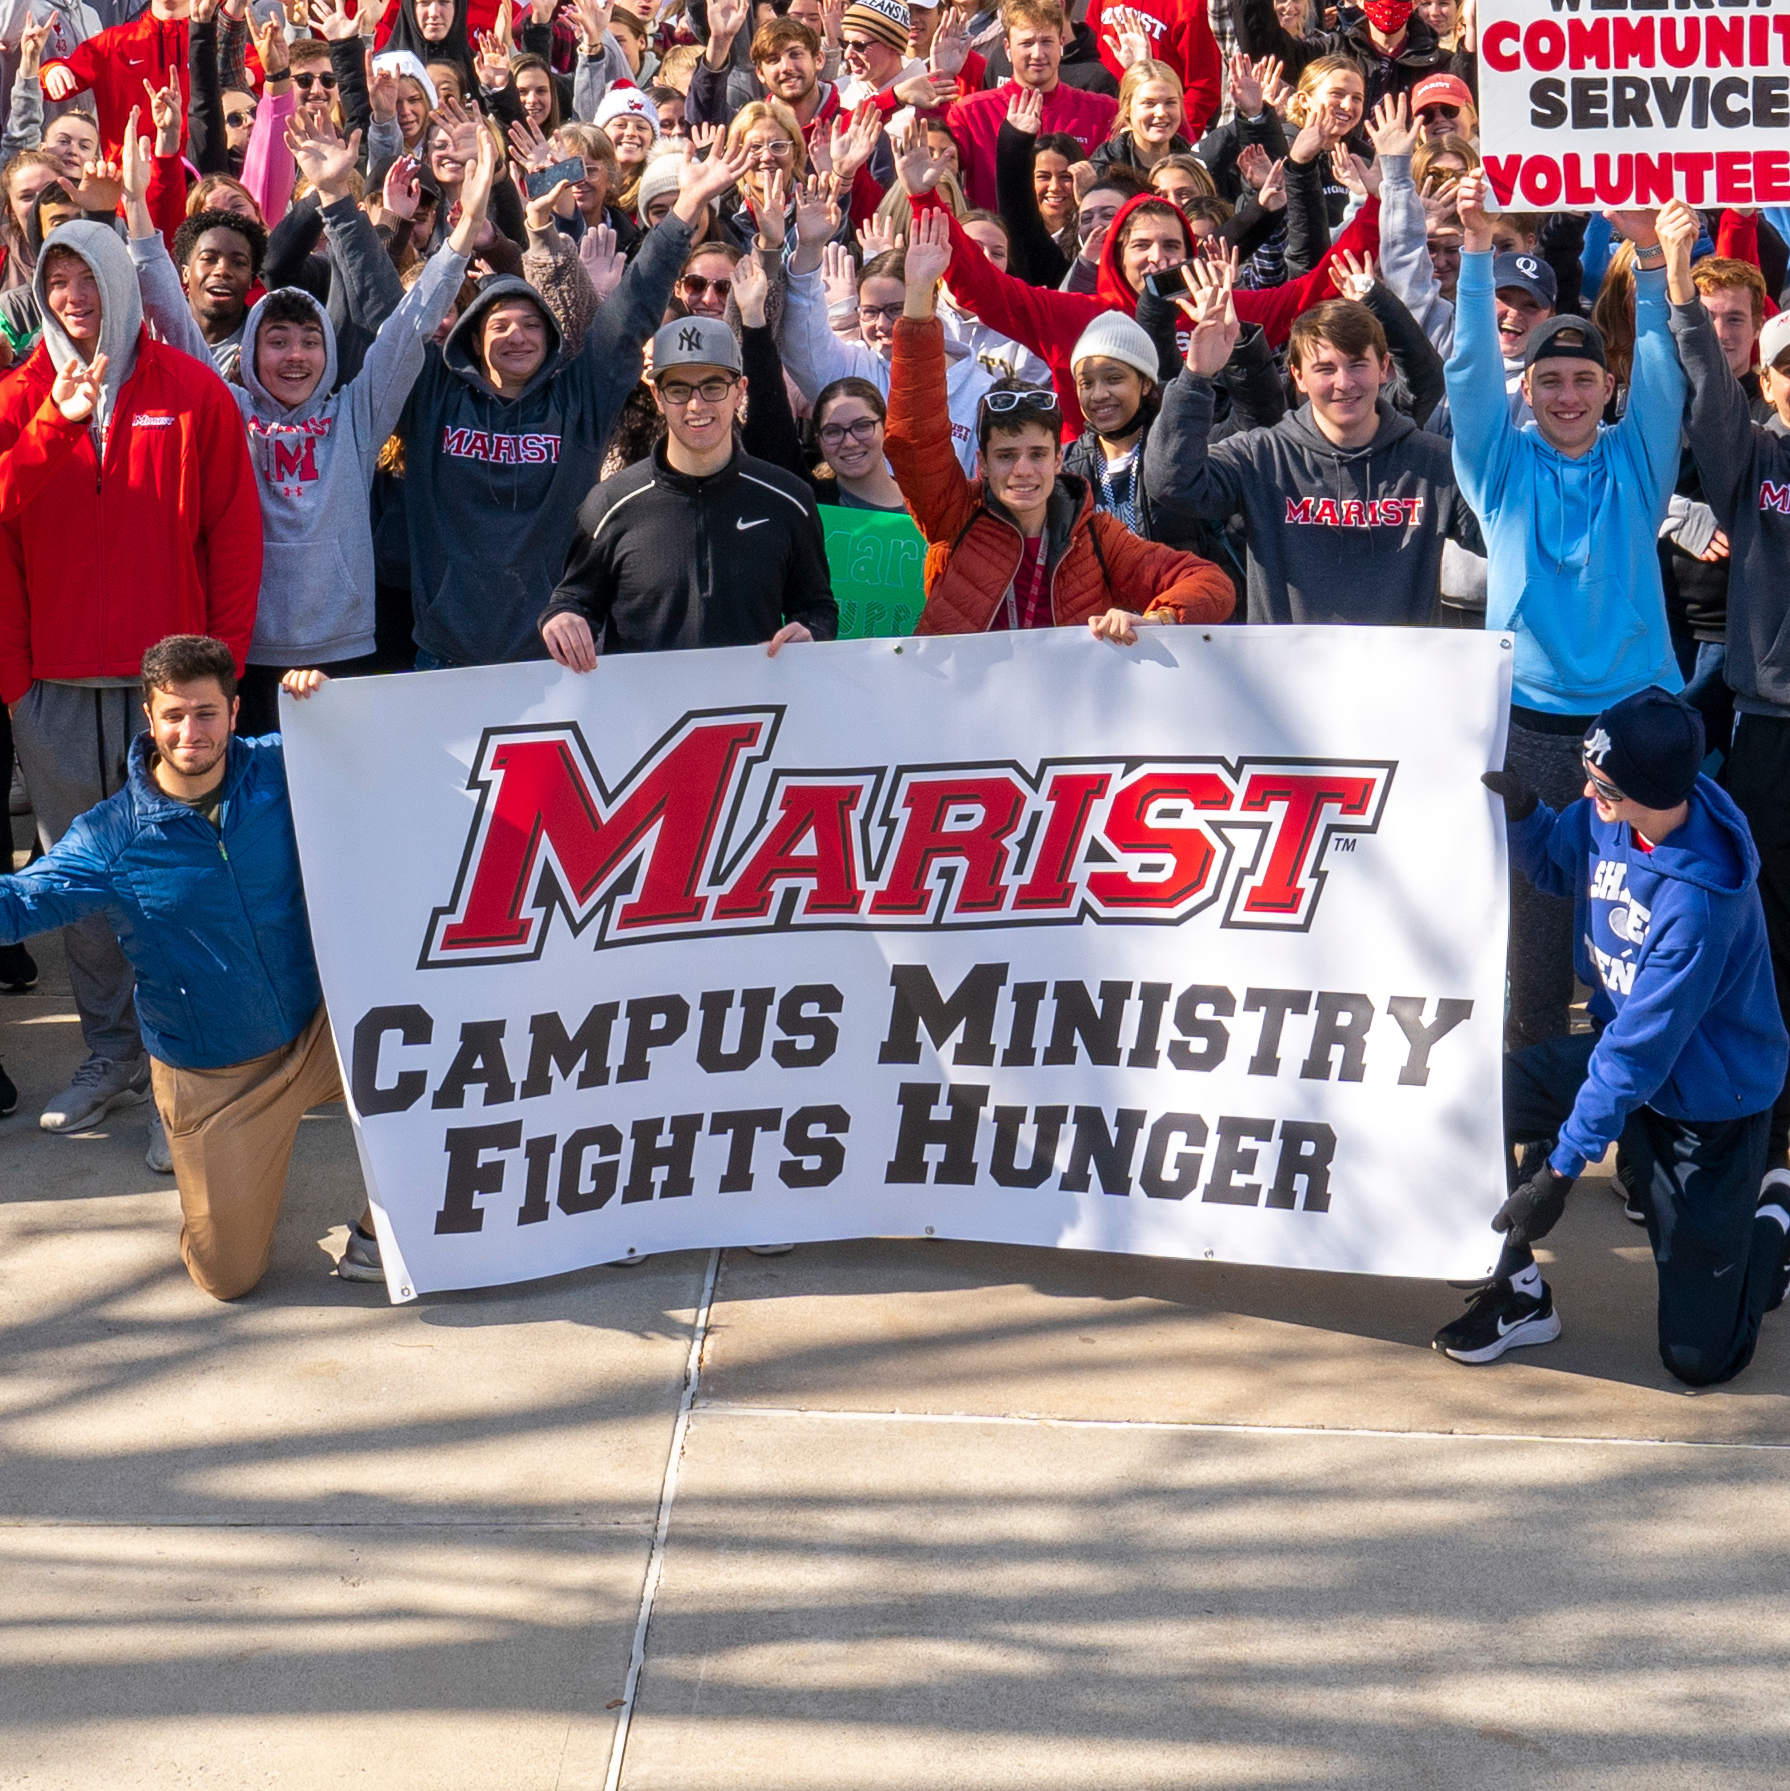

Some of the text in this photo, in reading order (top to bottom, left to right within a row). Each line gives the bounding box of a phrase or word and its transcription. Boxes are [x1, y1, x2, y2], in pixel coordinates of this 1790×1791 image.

[55, 39, 68, 52] 43
[1530, 76, 1790, 130] SERVICE
[1515, 257, 1539, 279] Q
[442, 425, 562, 464] MARIST
[1285, 496, 1423, 528] MARIST
[416, 704, 1399, 970] MARIST
[352, 962, 1474, 1118] CAMPUS MINISTRY
[434, 1082, 1338, 1235] FIGHTS HUNGER
